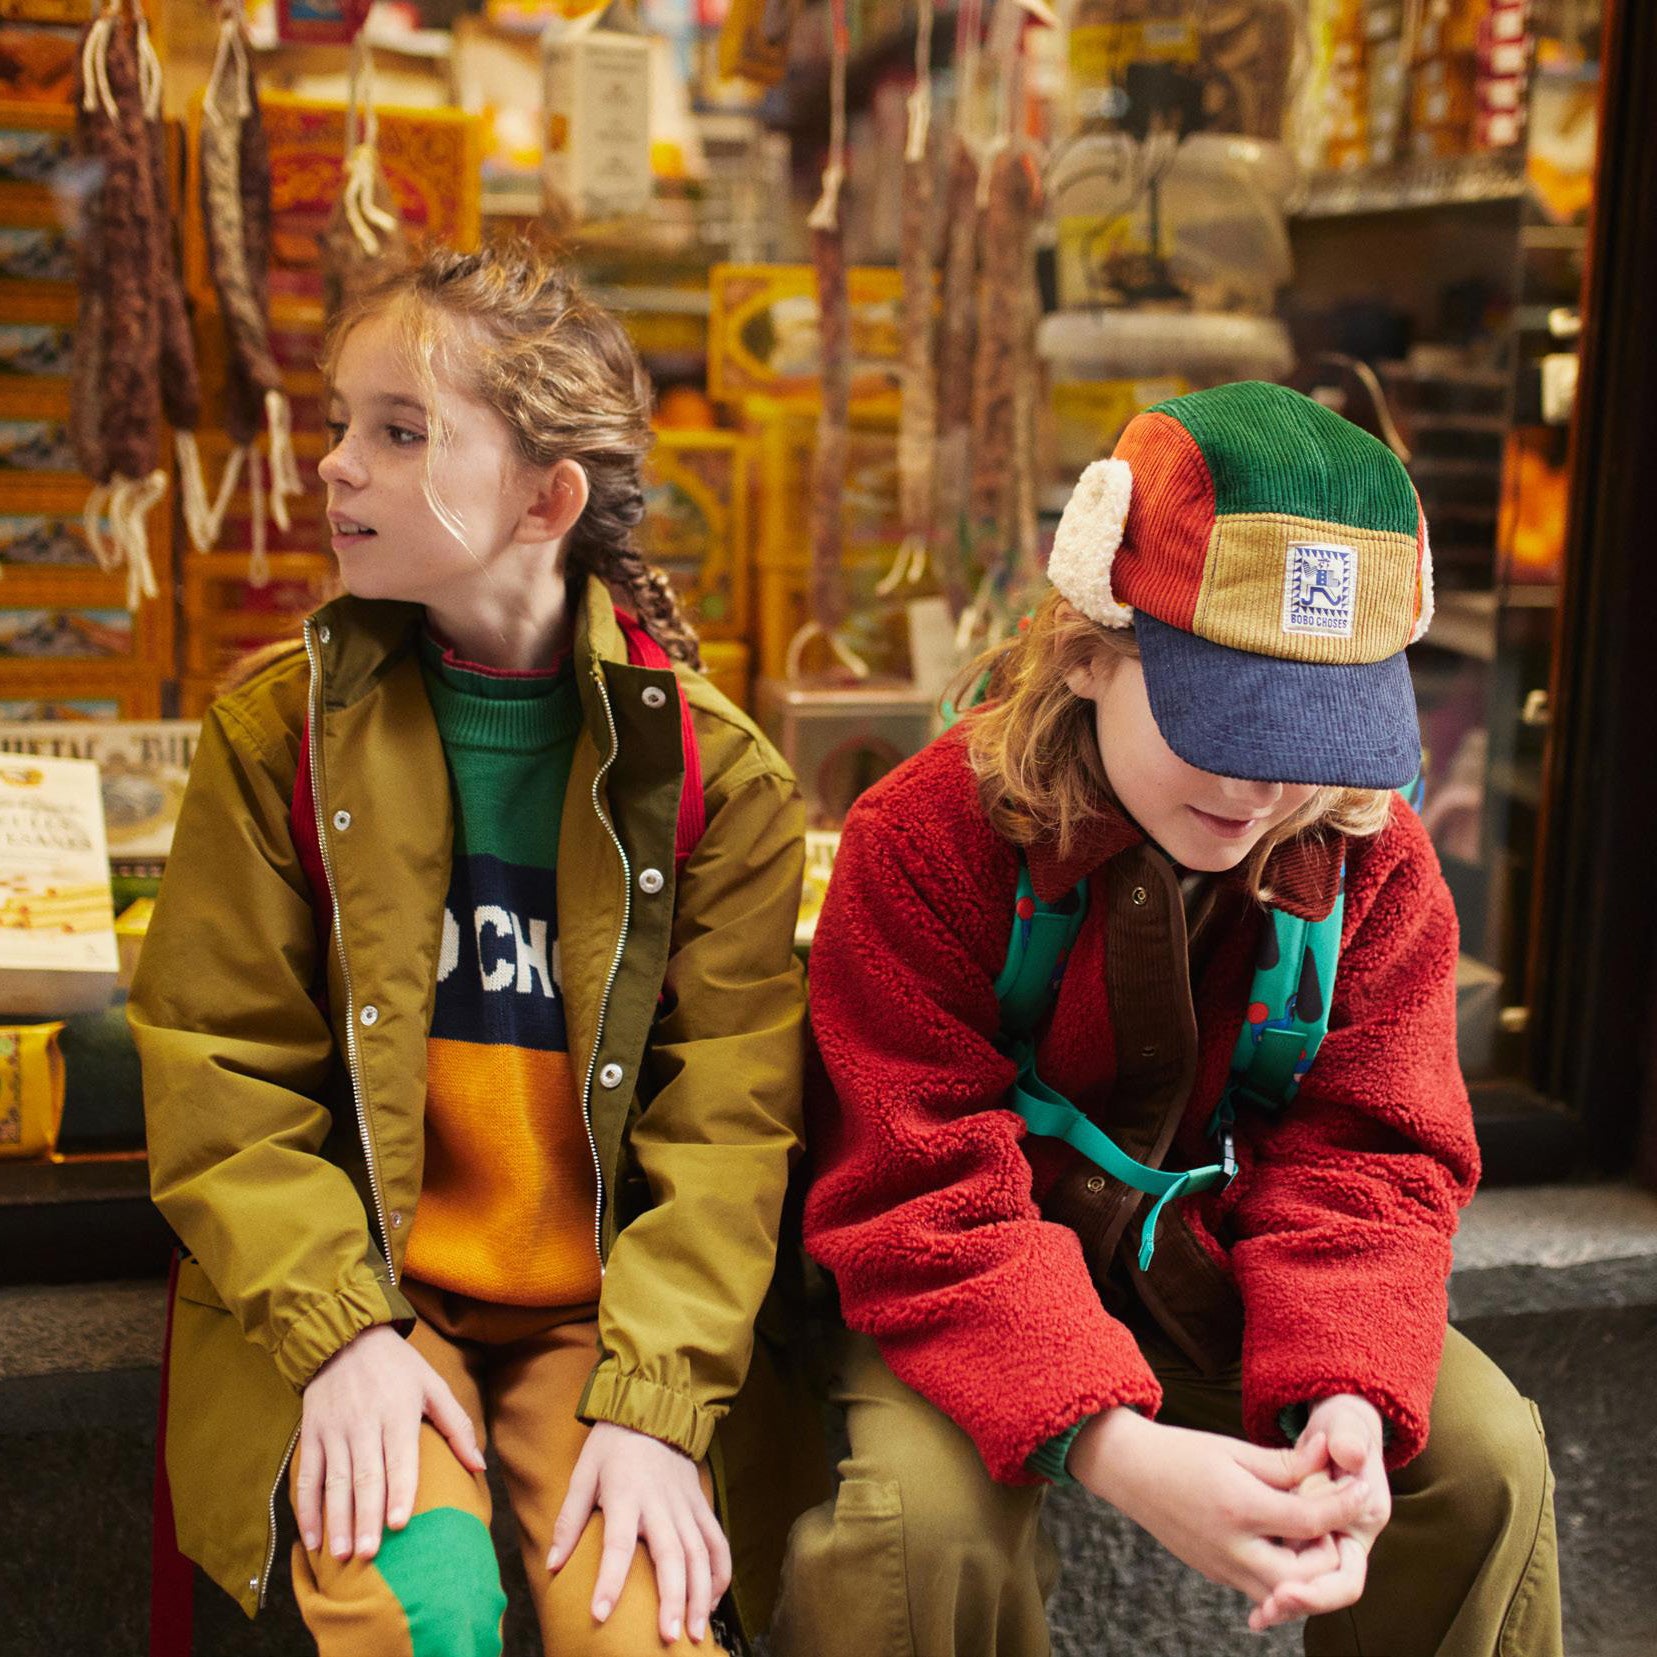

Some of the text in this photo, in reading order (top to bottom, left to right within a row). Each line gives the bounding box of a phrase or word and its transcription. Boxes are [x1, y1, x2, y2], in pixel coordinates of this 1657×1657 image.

[1291, 614, 1347, 628] BOBO CHOSES
[474, 905, 562, 998] CH
